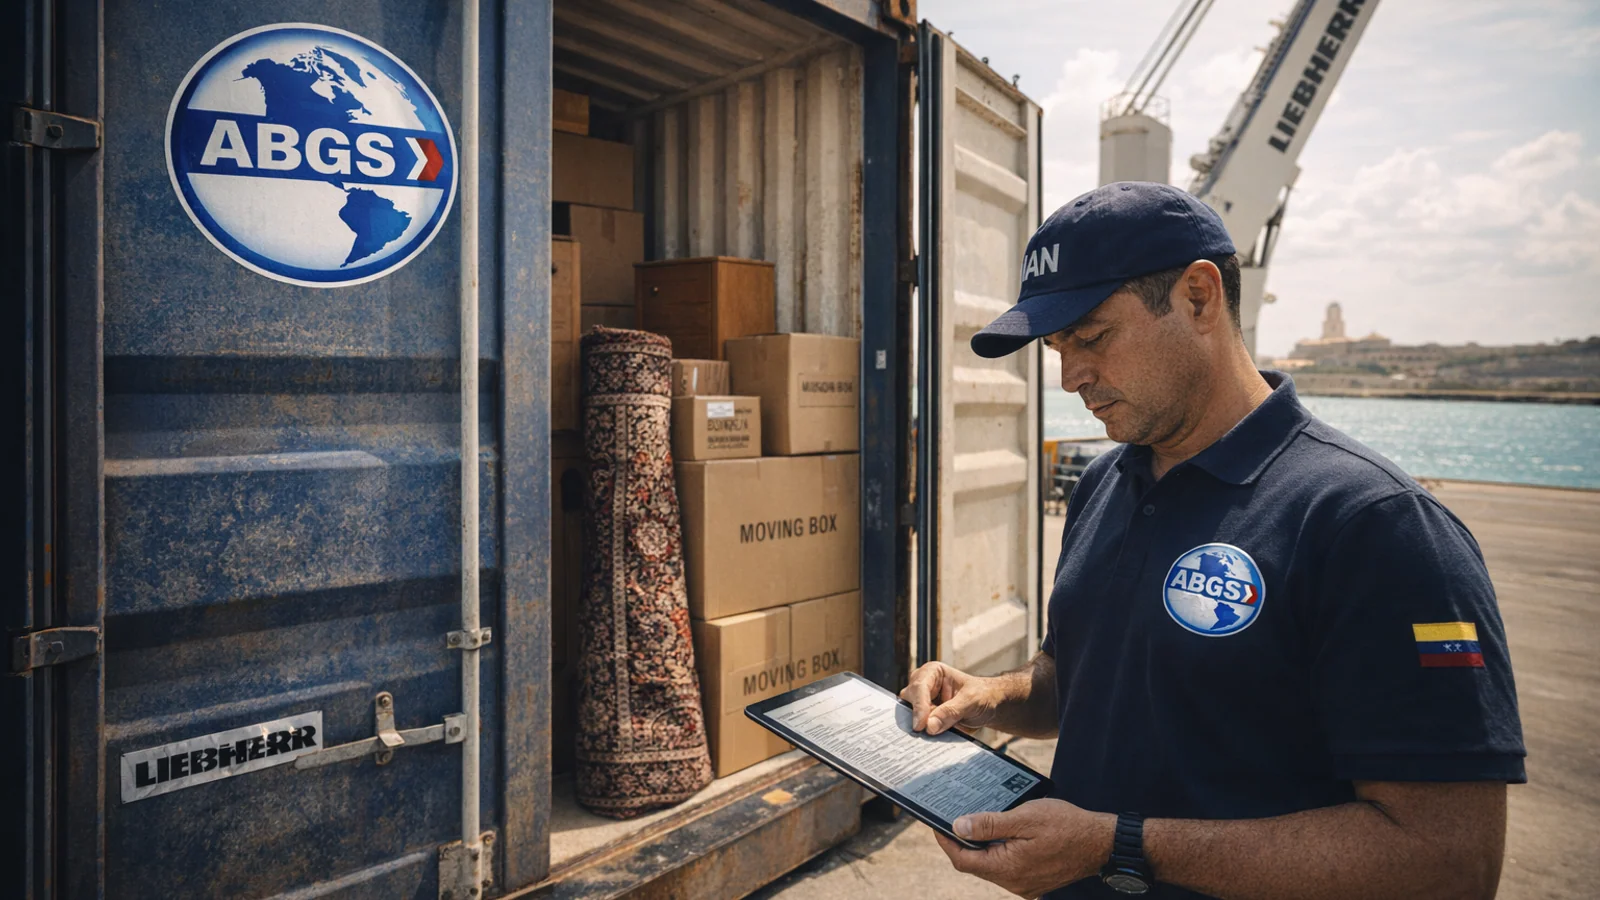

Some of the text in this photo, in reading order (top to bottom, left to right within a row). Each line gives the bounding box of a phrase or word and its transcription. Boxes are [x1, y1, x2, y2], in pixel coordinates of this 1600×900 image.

[200, 119, 396, 178] ABGS
[739, 514, 838, 544] MOVING BOX
[1170, 569, 1242, 601] ABGS
[743, 648, 841, 696] MOVING BOX
[135, 725, 318, 789] LIEBHERR
